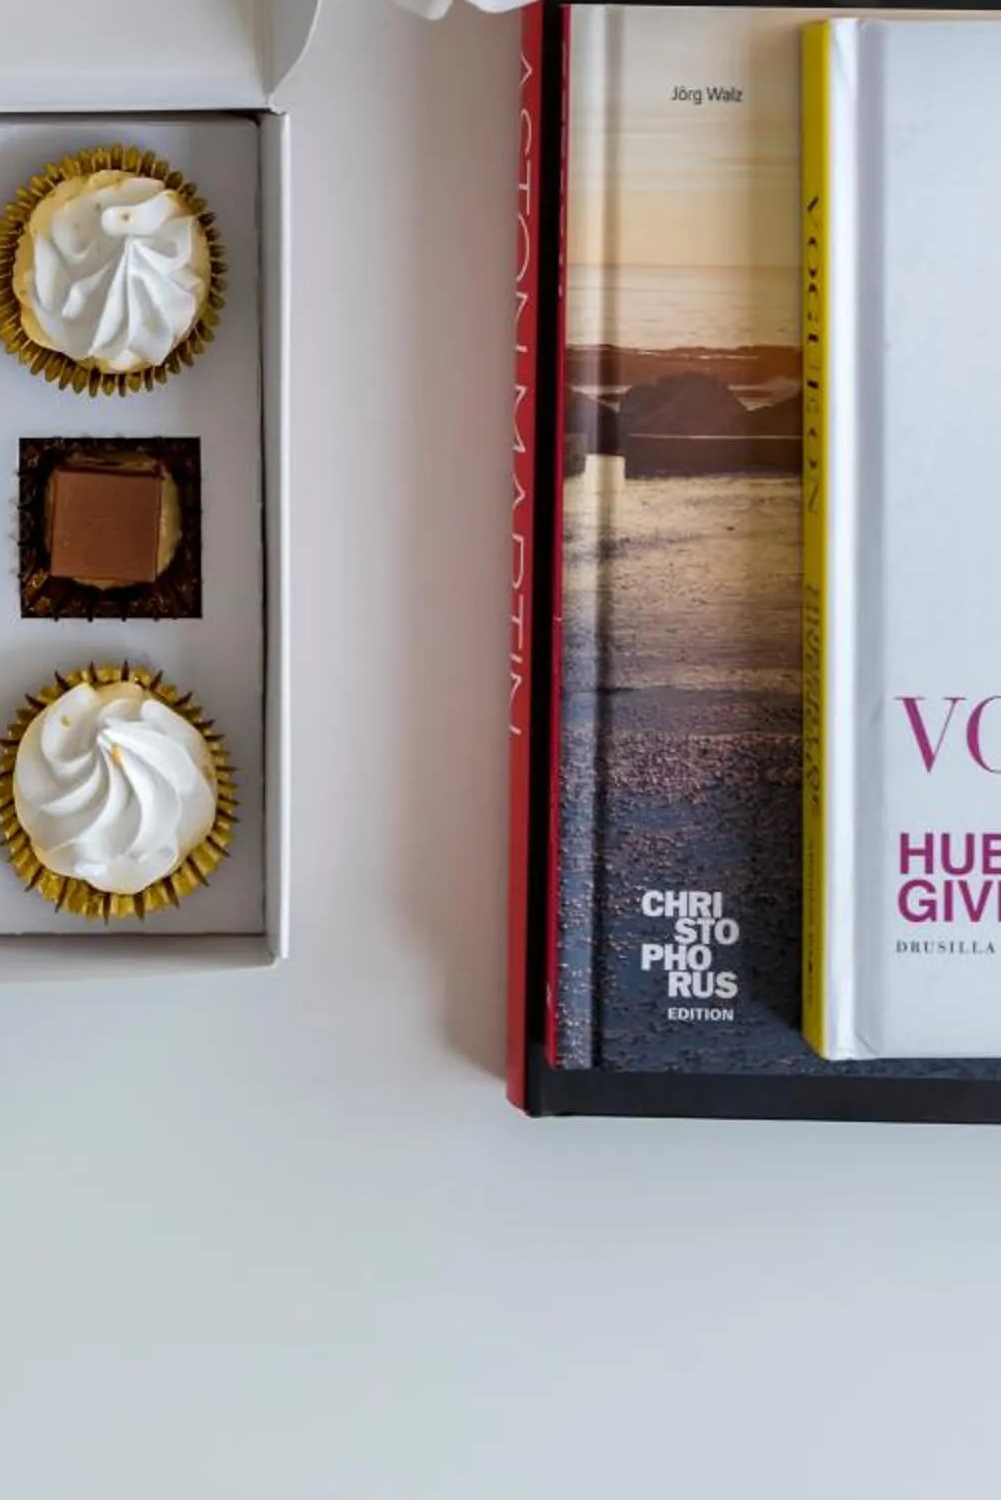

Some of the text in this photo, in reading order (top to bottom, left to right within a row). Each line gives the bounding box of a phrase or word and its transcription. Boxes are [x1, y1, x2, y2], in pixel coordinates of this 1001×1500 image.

[671, 86, 743, 105] Jörg Walz
[641, 889, 723, 918] CHRI
[898, 879, 1001, 923] GIV
[674, 918, 739, 945] STO
[641, 943, 712, 971] PHO
[895, 940, 996, 954] DRUSILLA
[668, 971, 738, 999] RUS
[667, 1007, 734, 1021] EDITION
